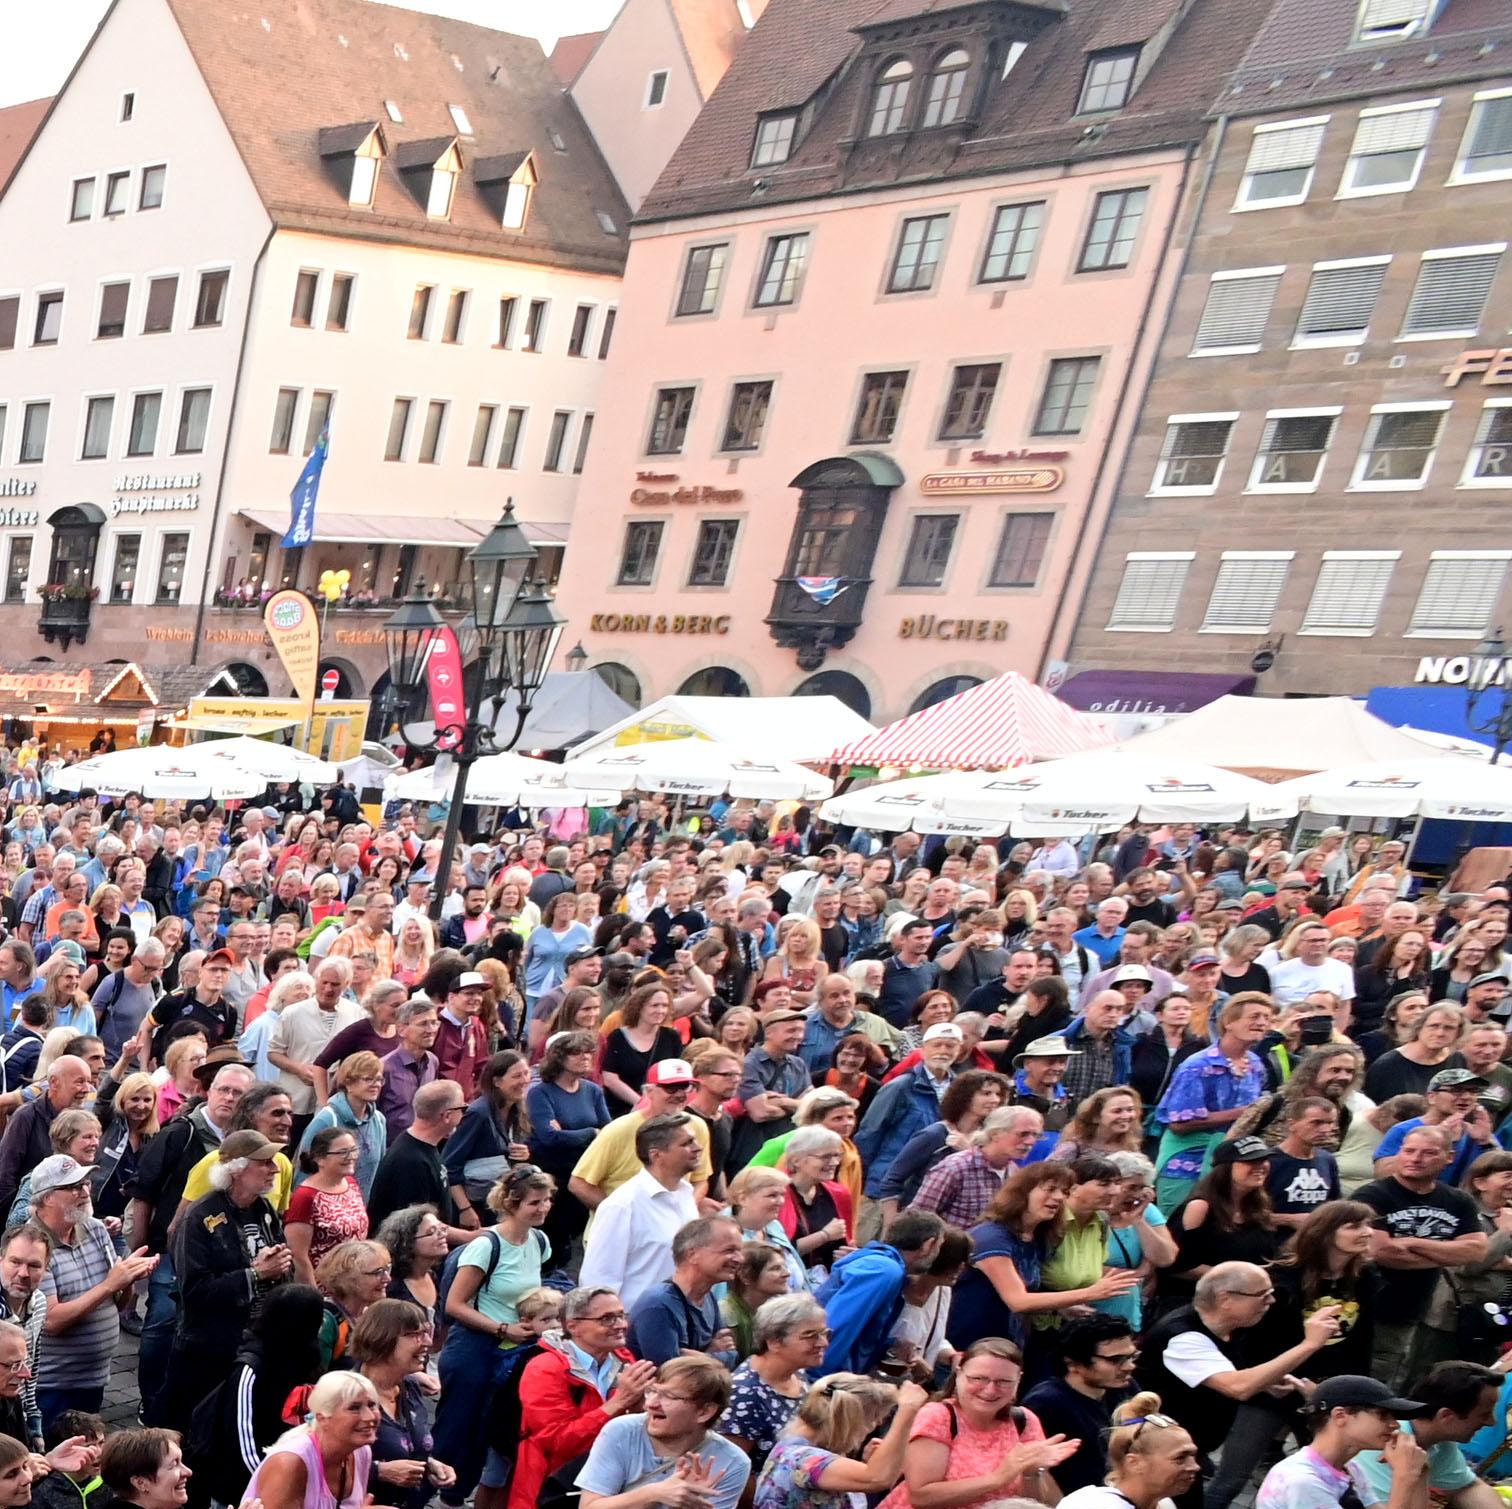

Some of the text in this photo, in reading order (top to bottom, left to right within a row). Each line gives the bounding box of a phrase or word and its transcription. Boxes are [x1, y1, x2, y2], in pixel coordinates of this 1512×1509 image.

[112, 472, 200, 492] Restaurant
[110, 495, 199, 517] Hauptmarkt
[590, 614, 651, 632] KORN
[654, 615, 668, 634] &
[898, 613, 1009, 641] BÜCHER
[1090, 700, 1166, 714] odilia
[668, 781, 704, 792] Tucher
[1063, 809, 1109, 820] Tucher
[1288, 1188, 1329, 1204] Kappa
